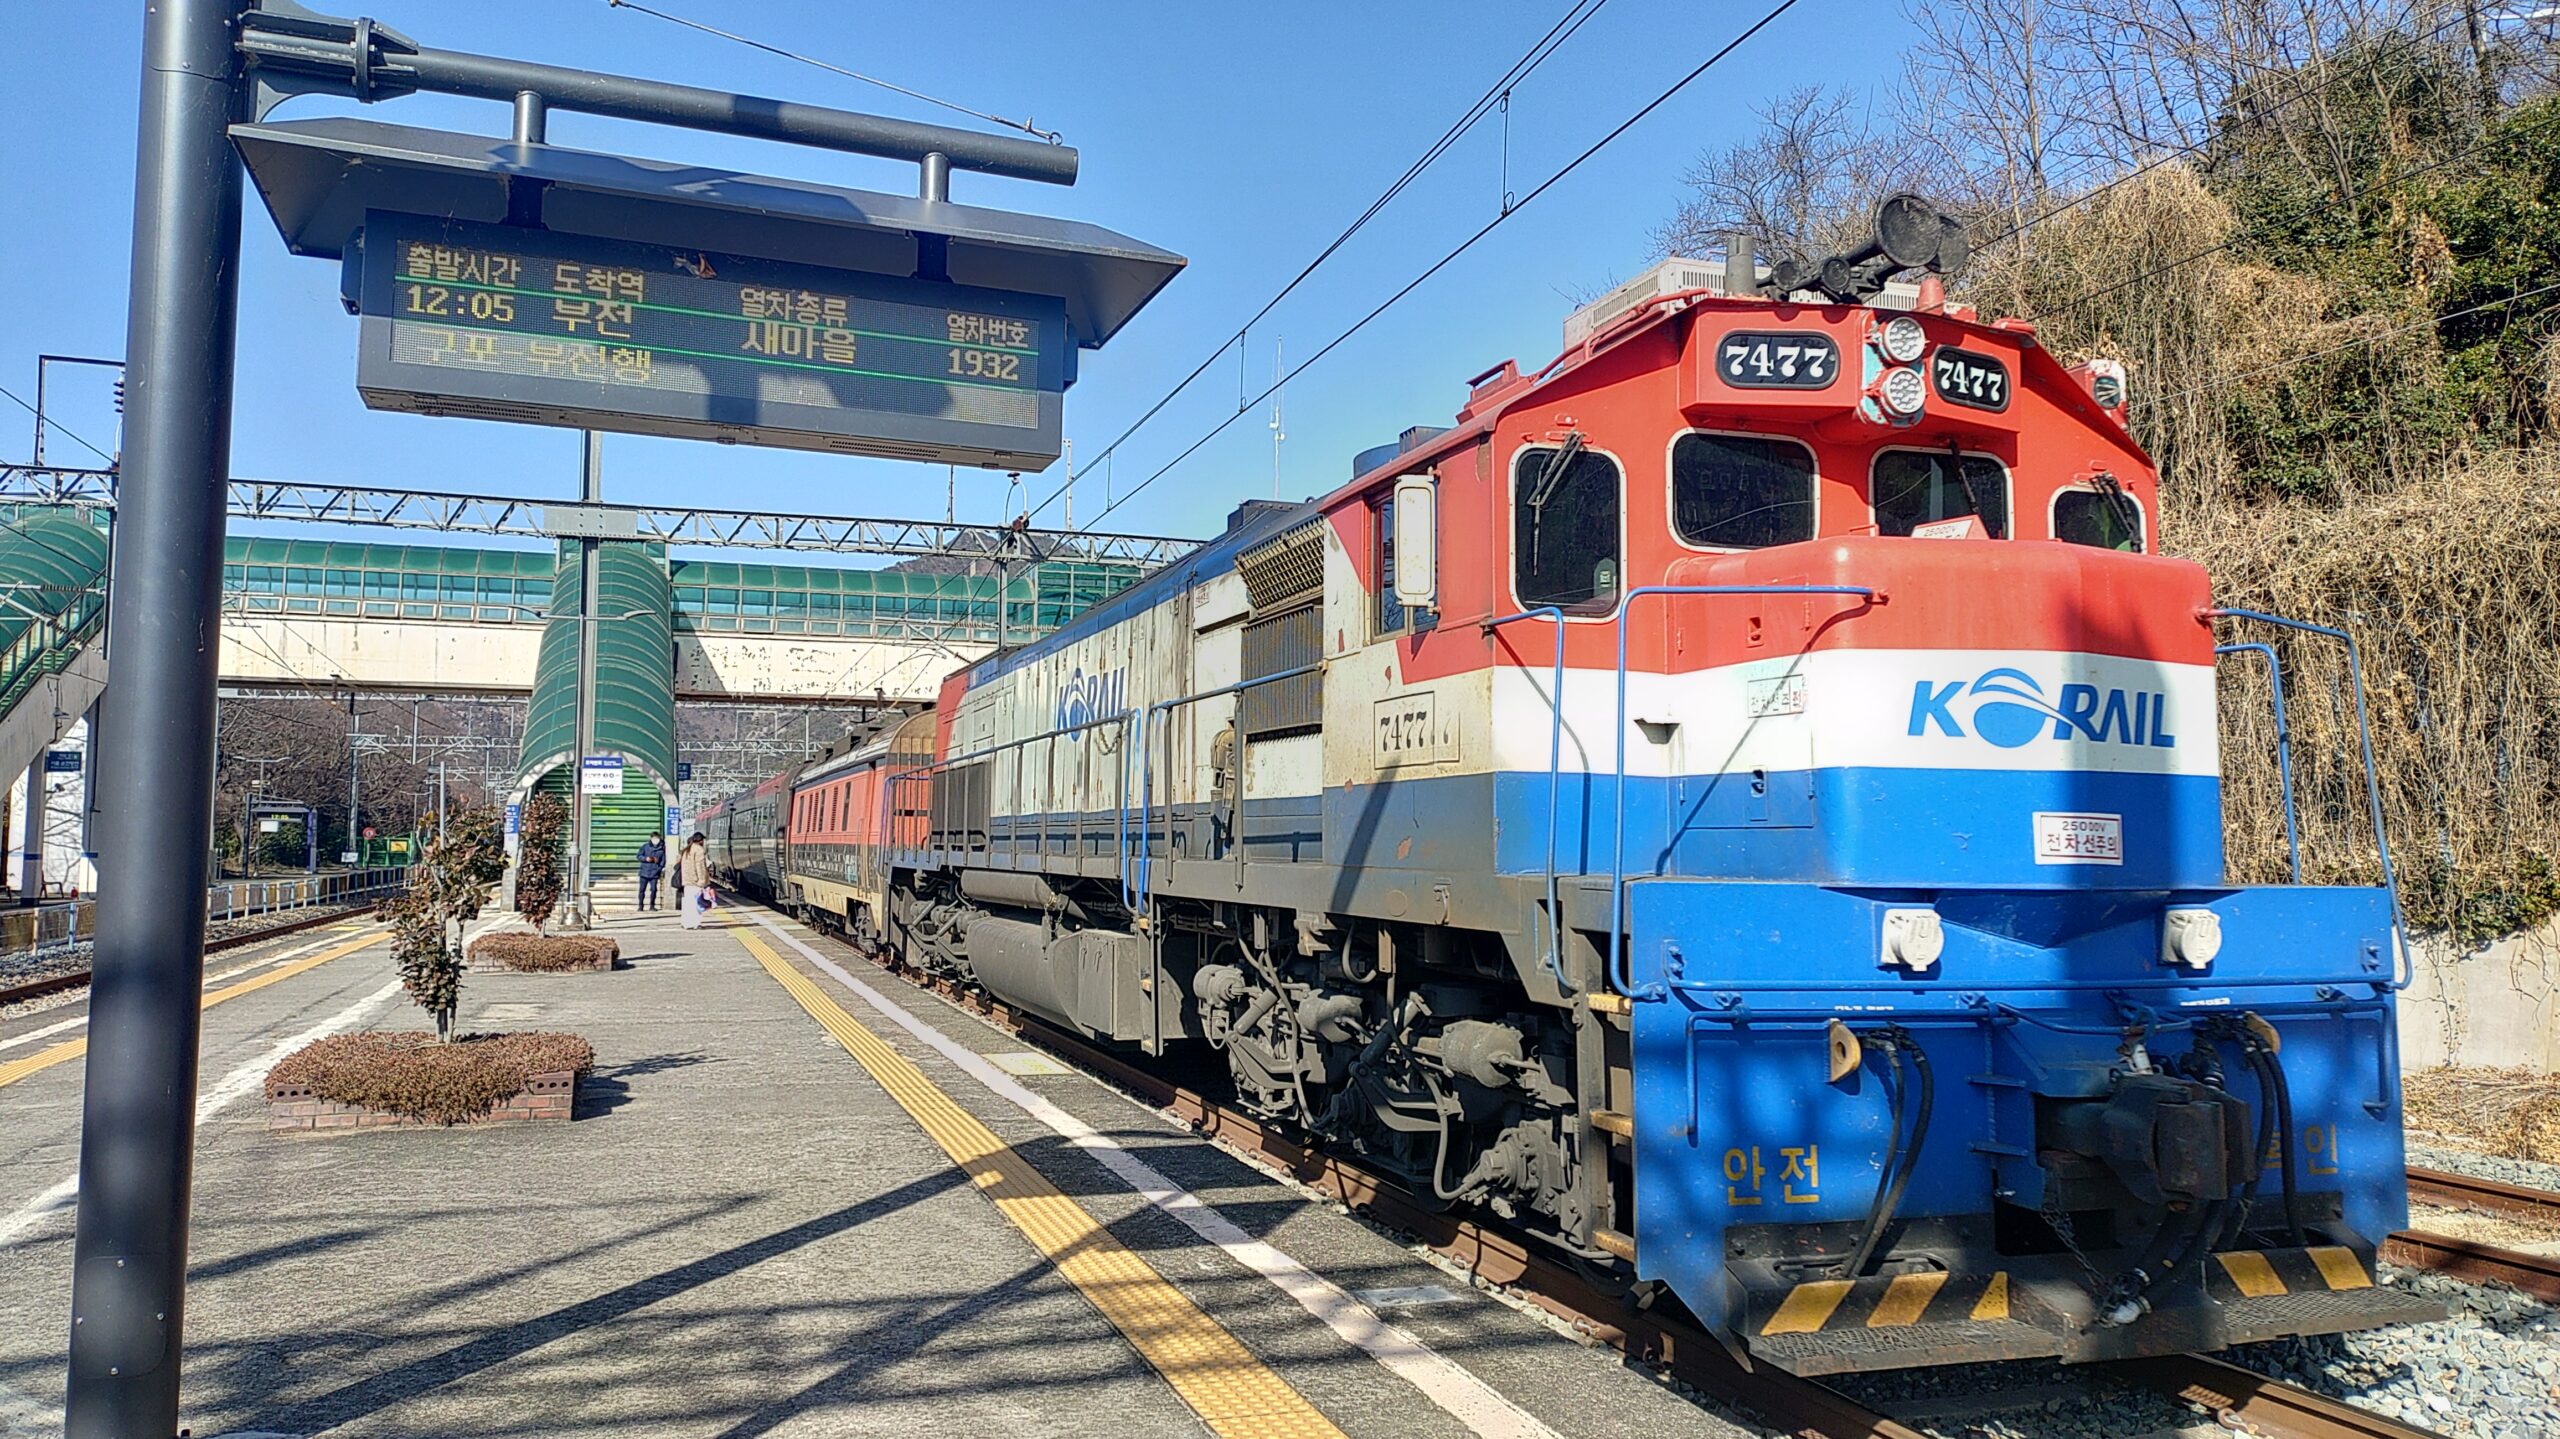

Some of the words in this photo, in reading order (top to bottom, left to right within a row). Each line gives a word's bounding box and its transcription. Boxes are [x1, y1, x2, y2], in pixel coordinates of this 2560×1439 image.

[407, 245, 521, 288] 출발시간
[554, 263, 644, 302] 도착역
[740, 287, 848, 328] 열차종류
[947, 313, 1029, 348] 열차번호
[407, 284, 514, 322] 12:05
[553, 299, 632, 338] 부전
[740, 319, 856, 364] 새마을
[948, 348, 1019, 380] 1932
[1725, 343, 1830, 378] 7477
[1937, 359, 2003, 402] 7477
[1056, 666, 1128, 742] KORAIL
[1907, 667, 2176, 749] KORAIL
[1723, 1144, 1820, 1206] 안전
